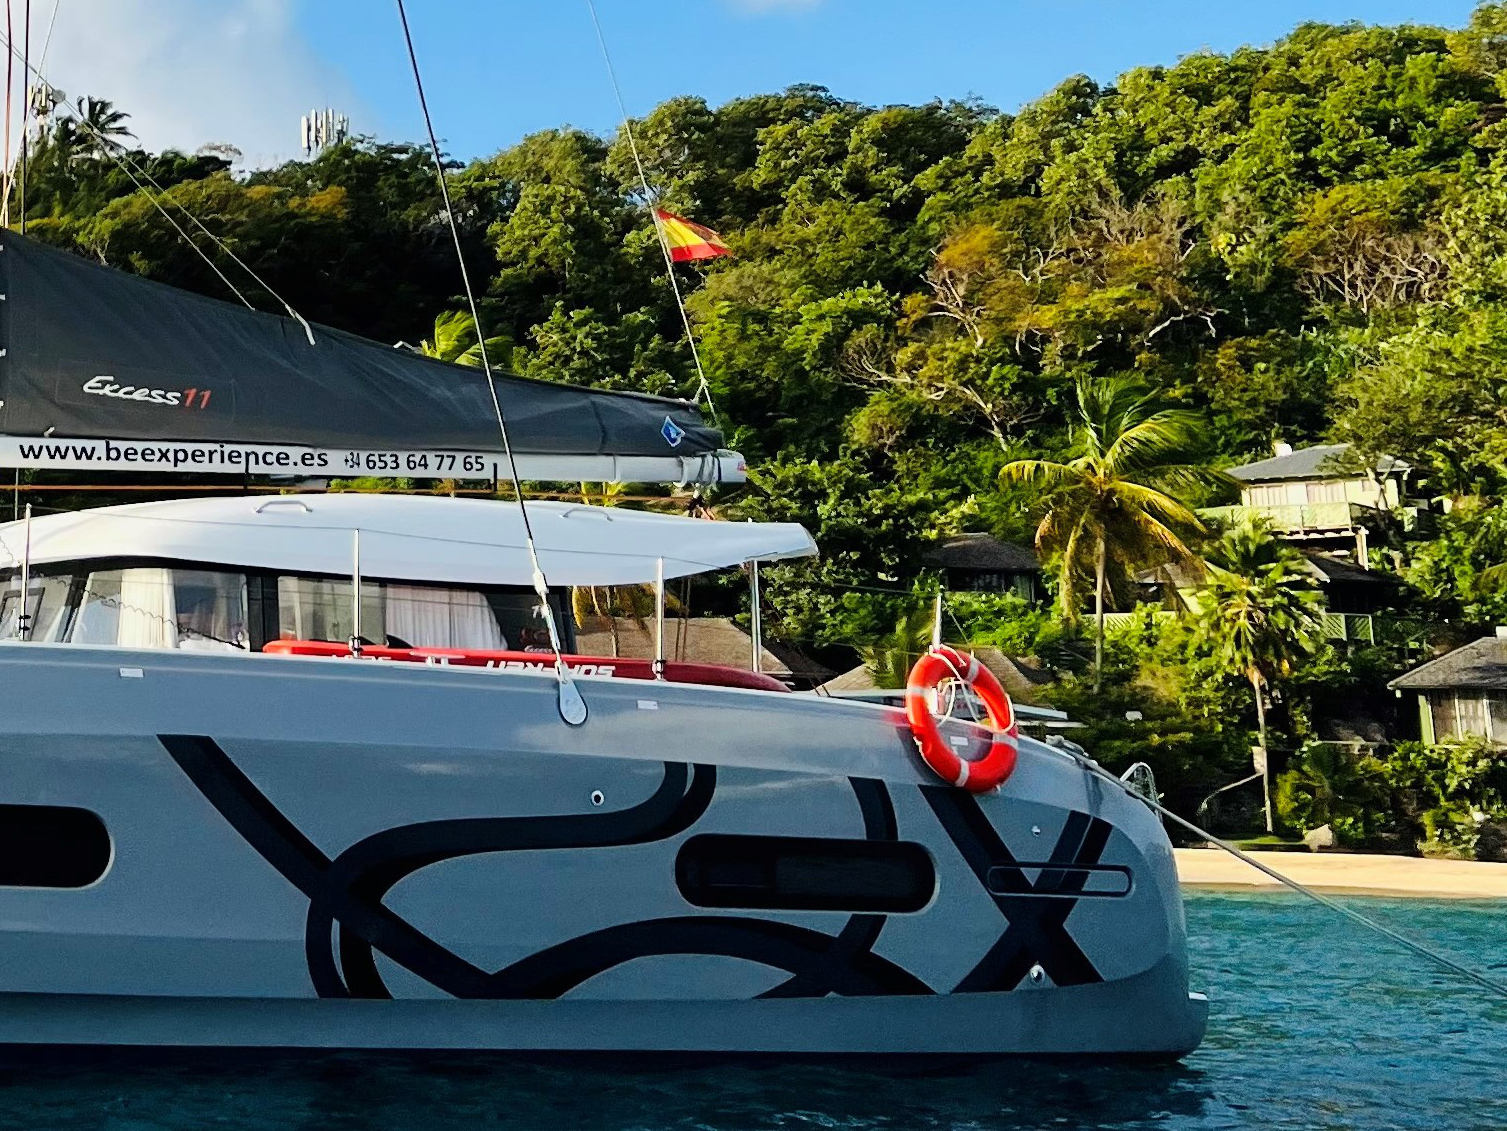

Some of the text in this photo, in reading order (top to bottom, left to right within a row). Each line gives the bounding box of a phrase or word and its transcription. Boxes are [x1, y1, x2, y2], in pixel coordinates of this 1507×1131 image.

[19, 440, 484, 471] www.beexperience.es +34 653 64 77 65
